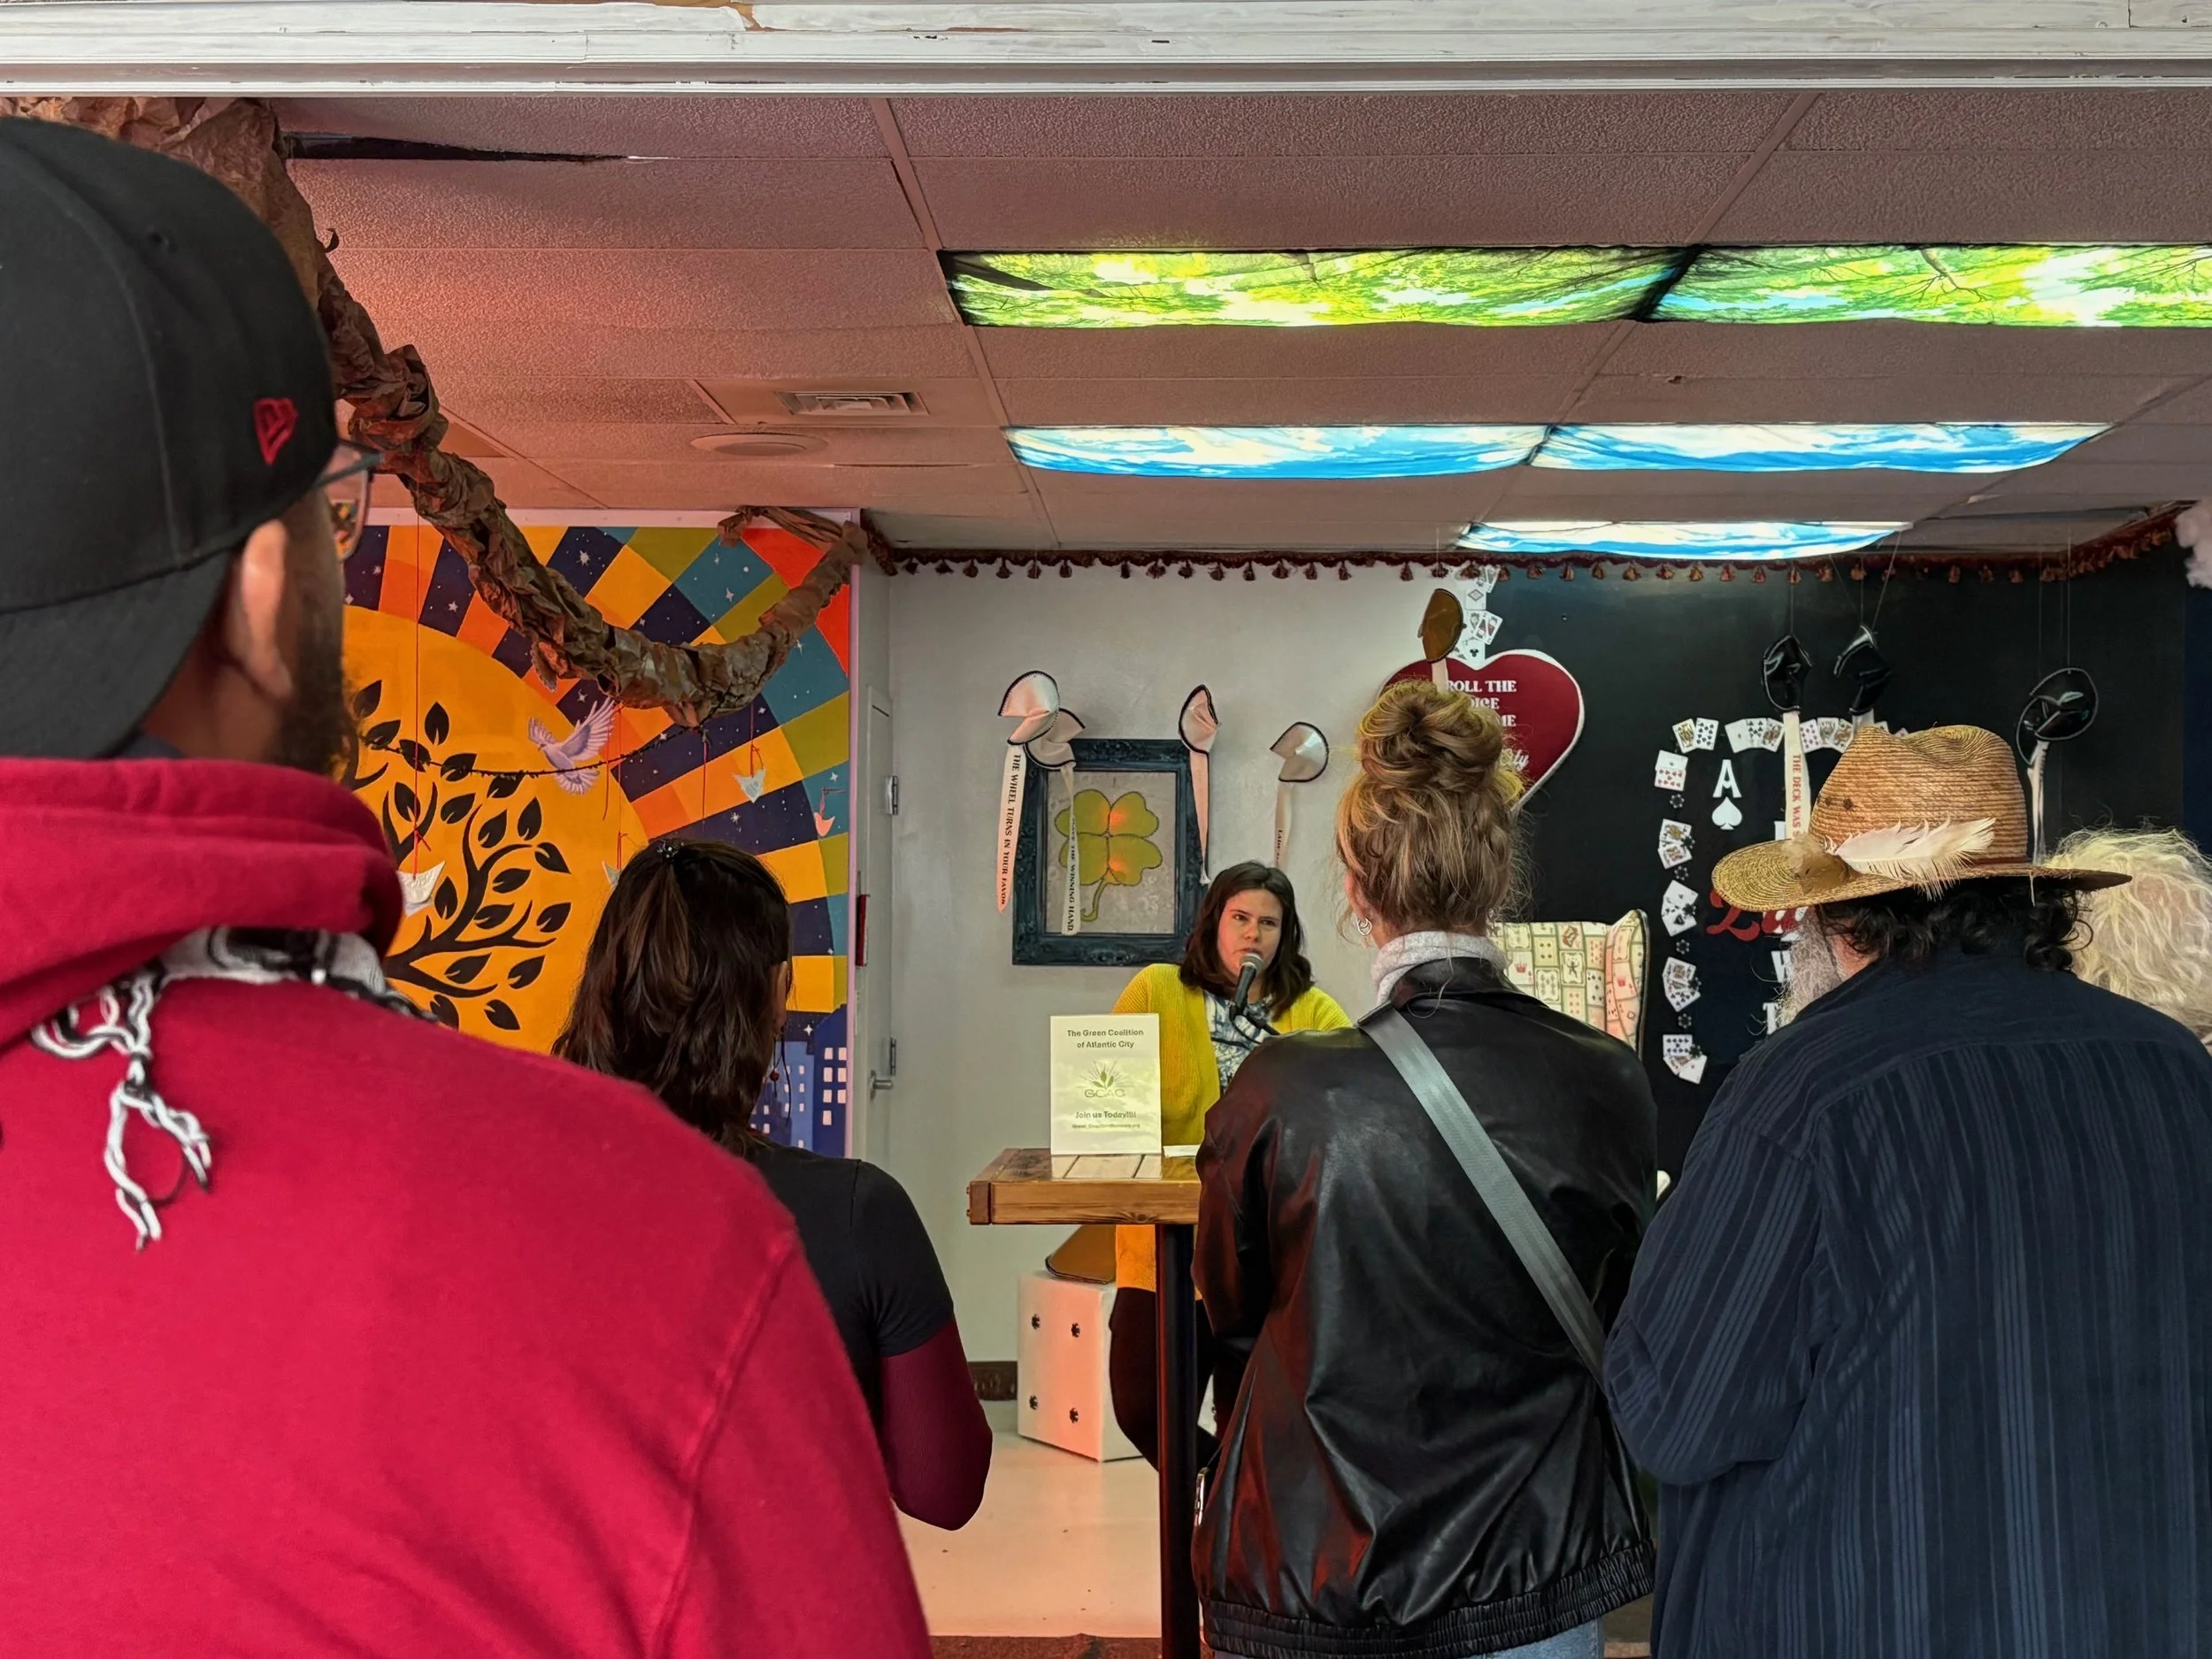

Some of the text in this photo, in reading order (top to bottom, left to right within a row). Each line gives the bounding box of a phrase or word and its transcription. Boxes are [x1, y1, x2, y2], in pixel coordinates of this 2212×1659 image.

[1448, 680, 1517, 693] ROLL THE
[1011, 754, 1022, 772] THE
[1792, 754, 1802, 772] THE
[1007, 774, 1019, 804] WHEEL
[1712, 759, 1742, 798] A
[1792, 776, 1801, 802] DECK
[1003, 806, 1015, 836] TURNS
[1792, 806, 1801, 828] WAS
[1002, 838, 1011, 849] IN
[1001, 850, 1010, 875] YOUR
[1118, 1040, 1134, 1049] City
